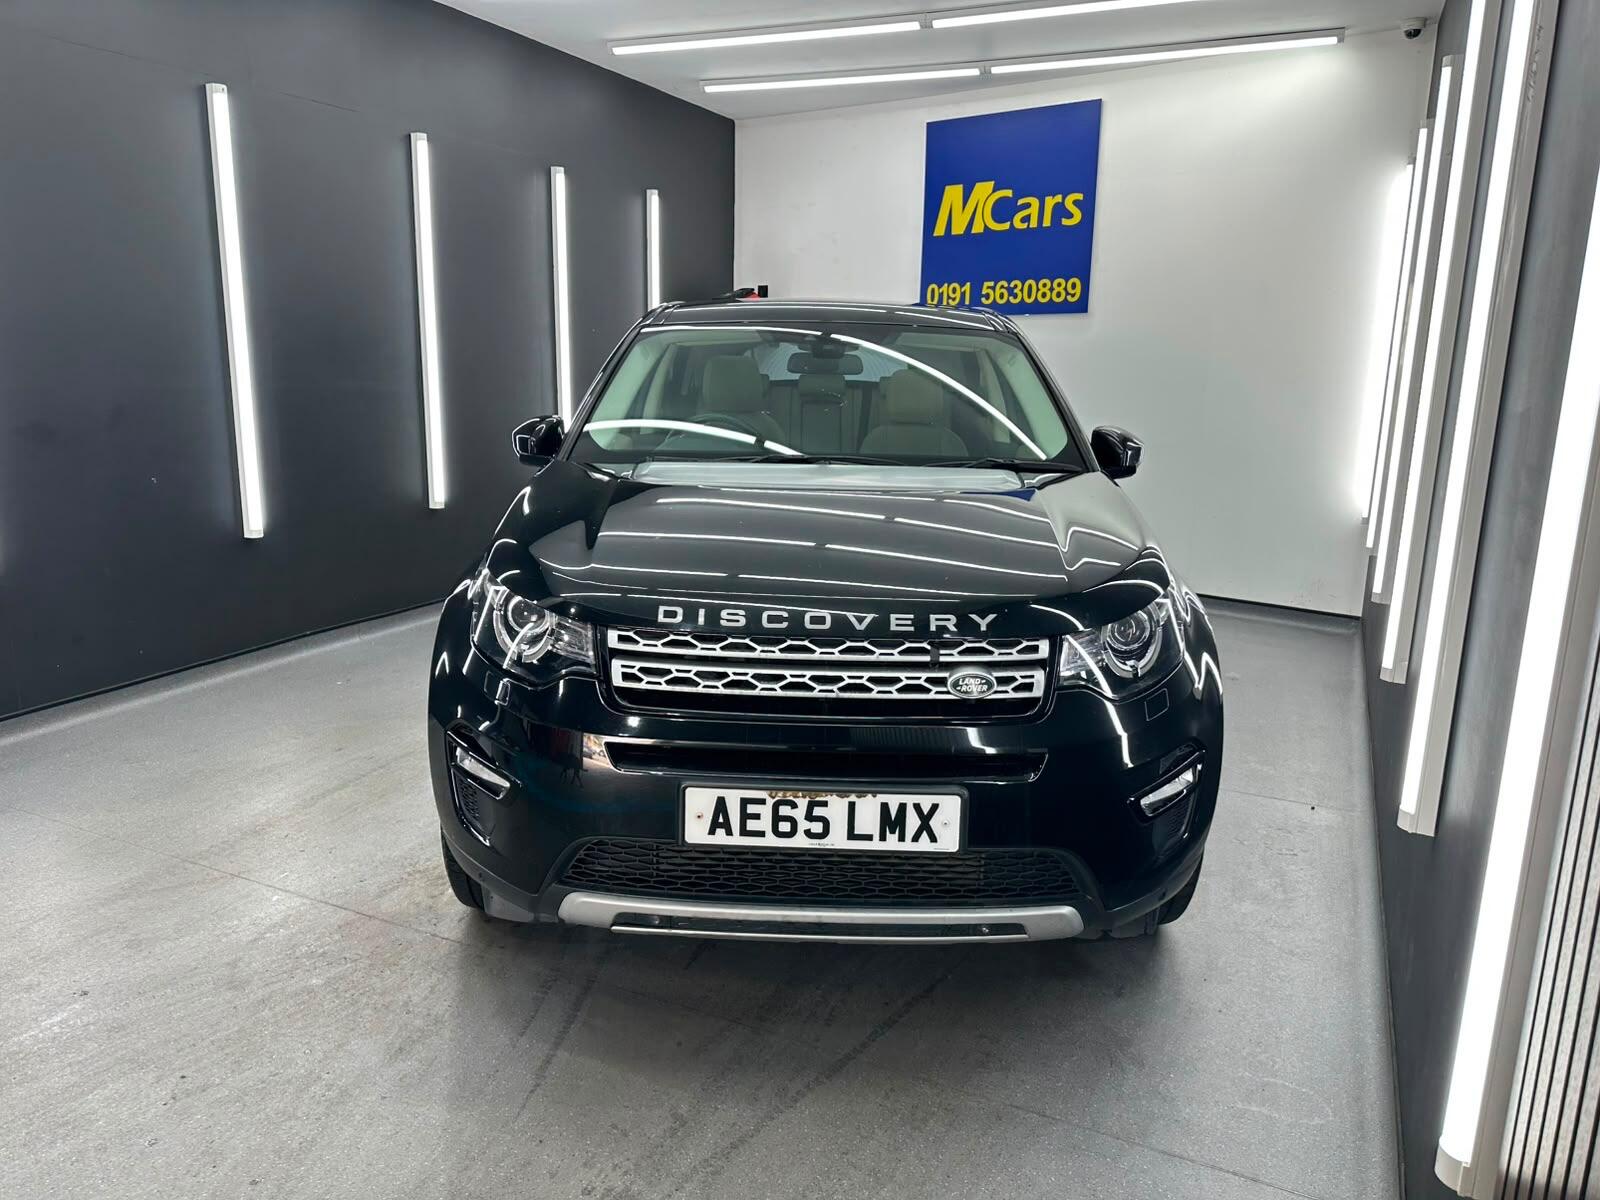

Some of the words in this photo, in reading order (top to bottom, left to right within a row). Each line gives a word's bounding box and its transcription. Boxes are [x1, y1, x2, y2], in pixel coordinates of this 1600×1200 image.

[926, 282, 971, 305] 0191
[981, 277, 1081, 304] 5630889
[657, 605, 997, 631] DISCOVERY
[707, 796, 831, 840] AE65
[846, 801, 940, 843] LMX
